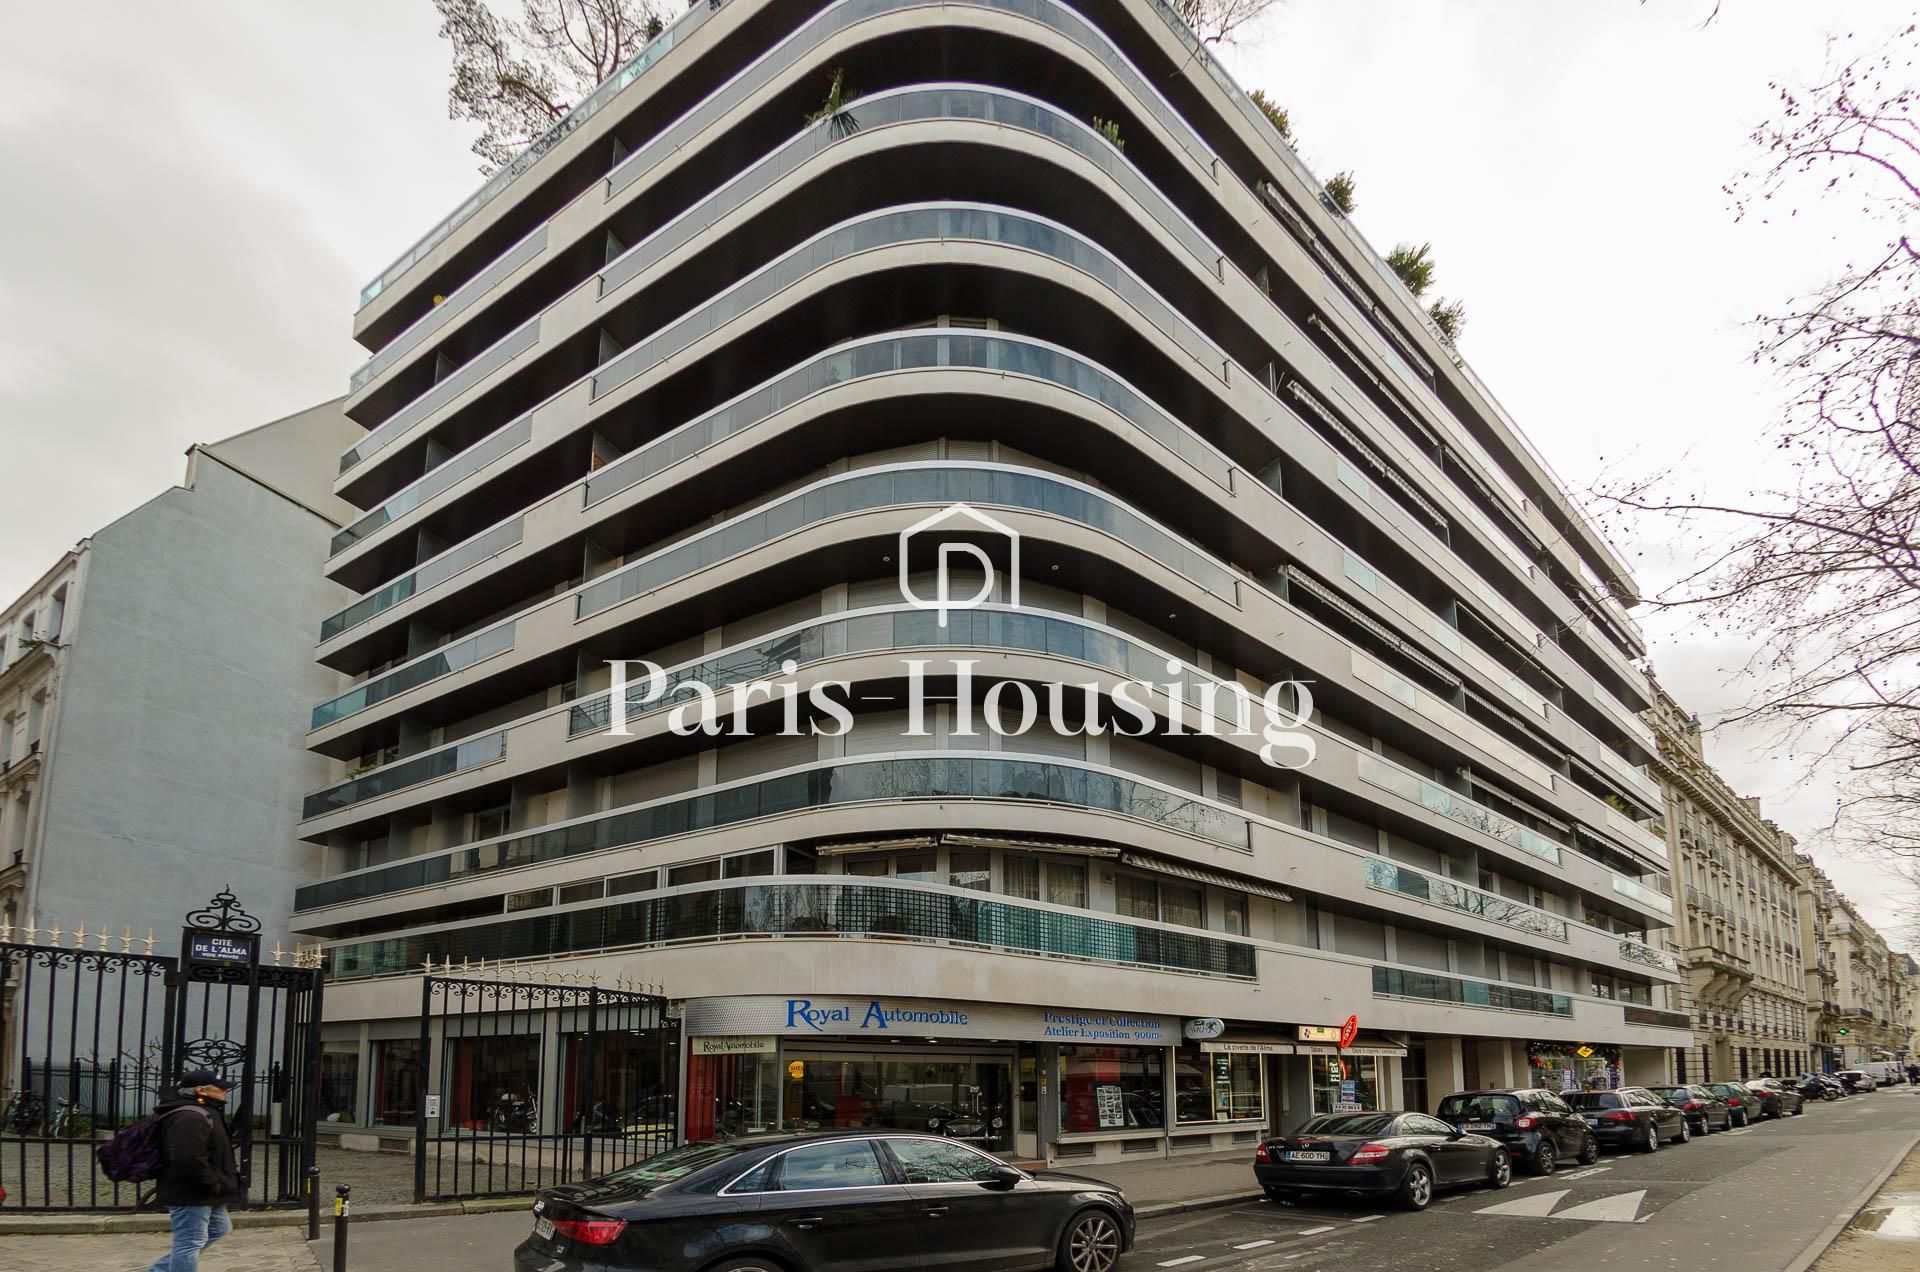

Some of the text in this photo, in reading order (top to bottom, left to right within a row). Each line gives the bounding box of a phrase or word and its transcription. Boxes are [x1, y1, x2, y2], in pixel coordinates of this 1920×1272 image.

[786, 999, 968, 1031] Royal Automobile
[1044, 1012, 1160, 1028] Prestige et Collection
[1044, 1026, 1079, 1037] Atelier
[1081, 1028, 1130, 1040] Exposition
[703, 1040, 765, 1053] Royal Automobile
